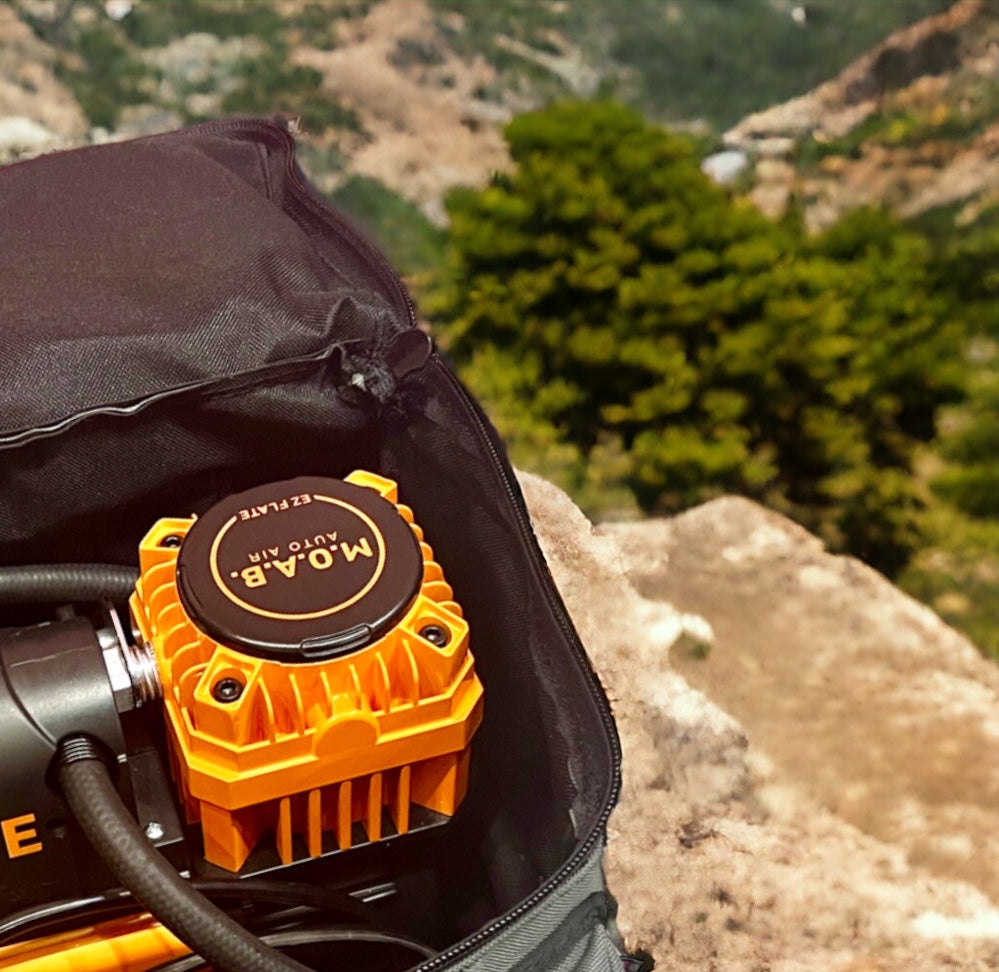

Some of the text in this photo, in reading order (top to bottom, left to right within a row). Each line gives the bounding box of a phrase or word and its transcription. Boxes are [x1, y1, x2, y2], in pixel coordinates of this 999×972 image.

[239, 493, 312, 521] EZ FLATE
[230, 537, 373, 588] M.O.A.B.
[248, 531, 338, 563] AUTO AIR
